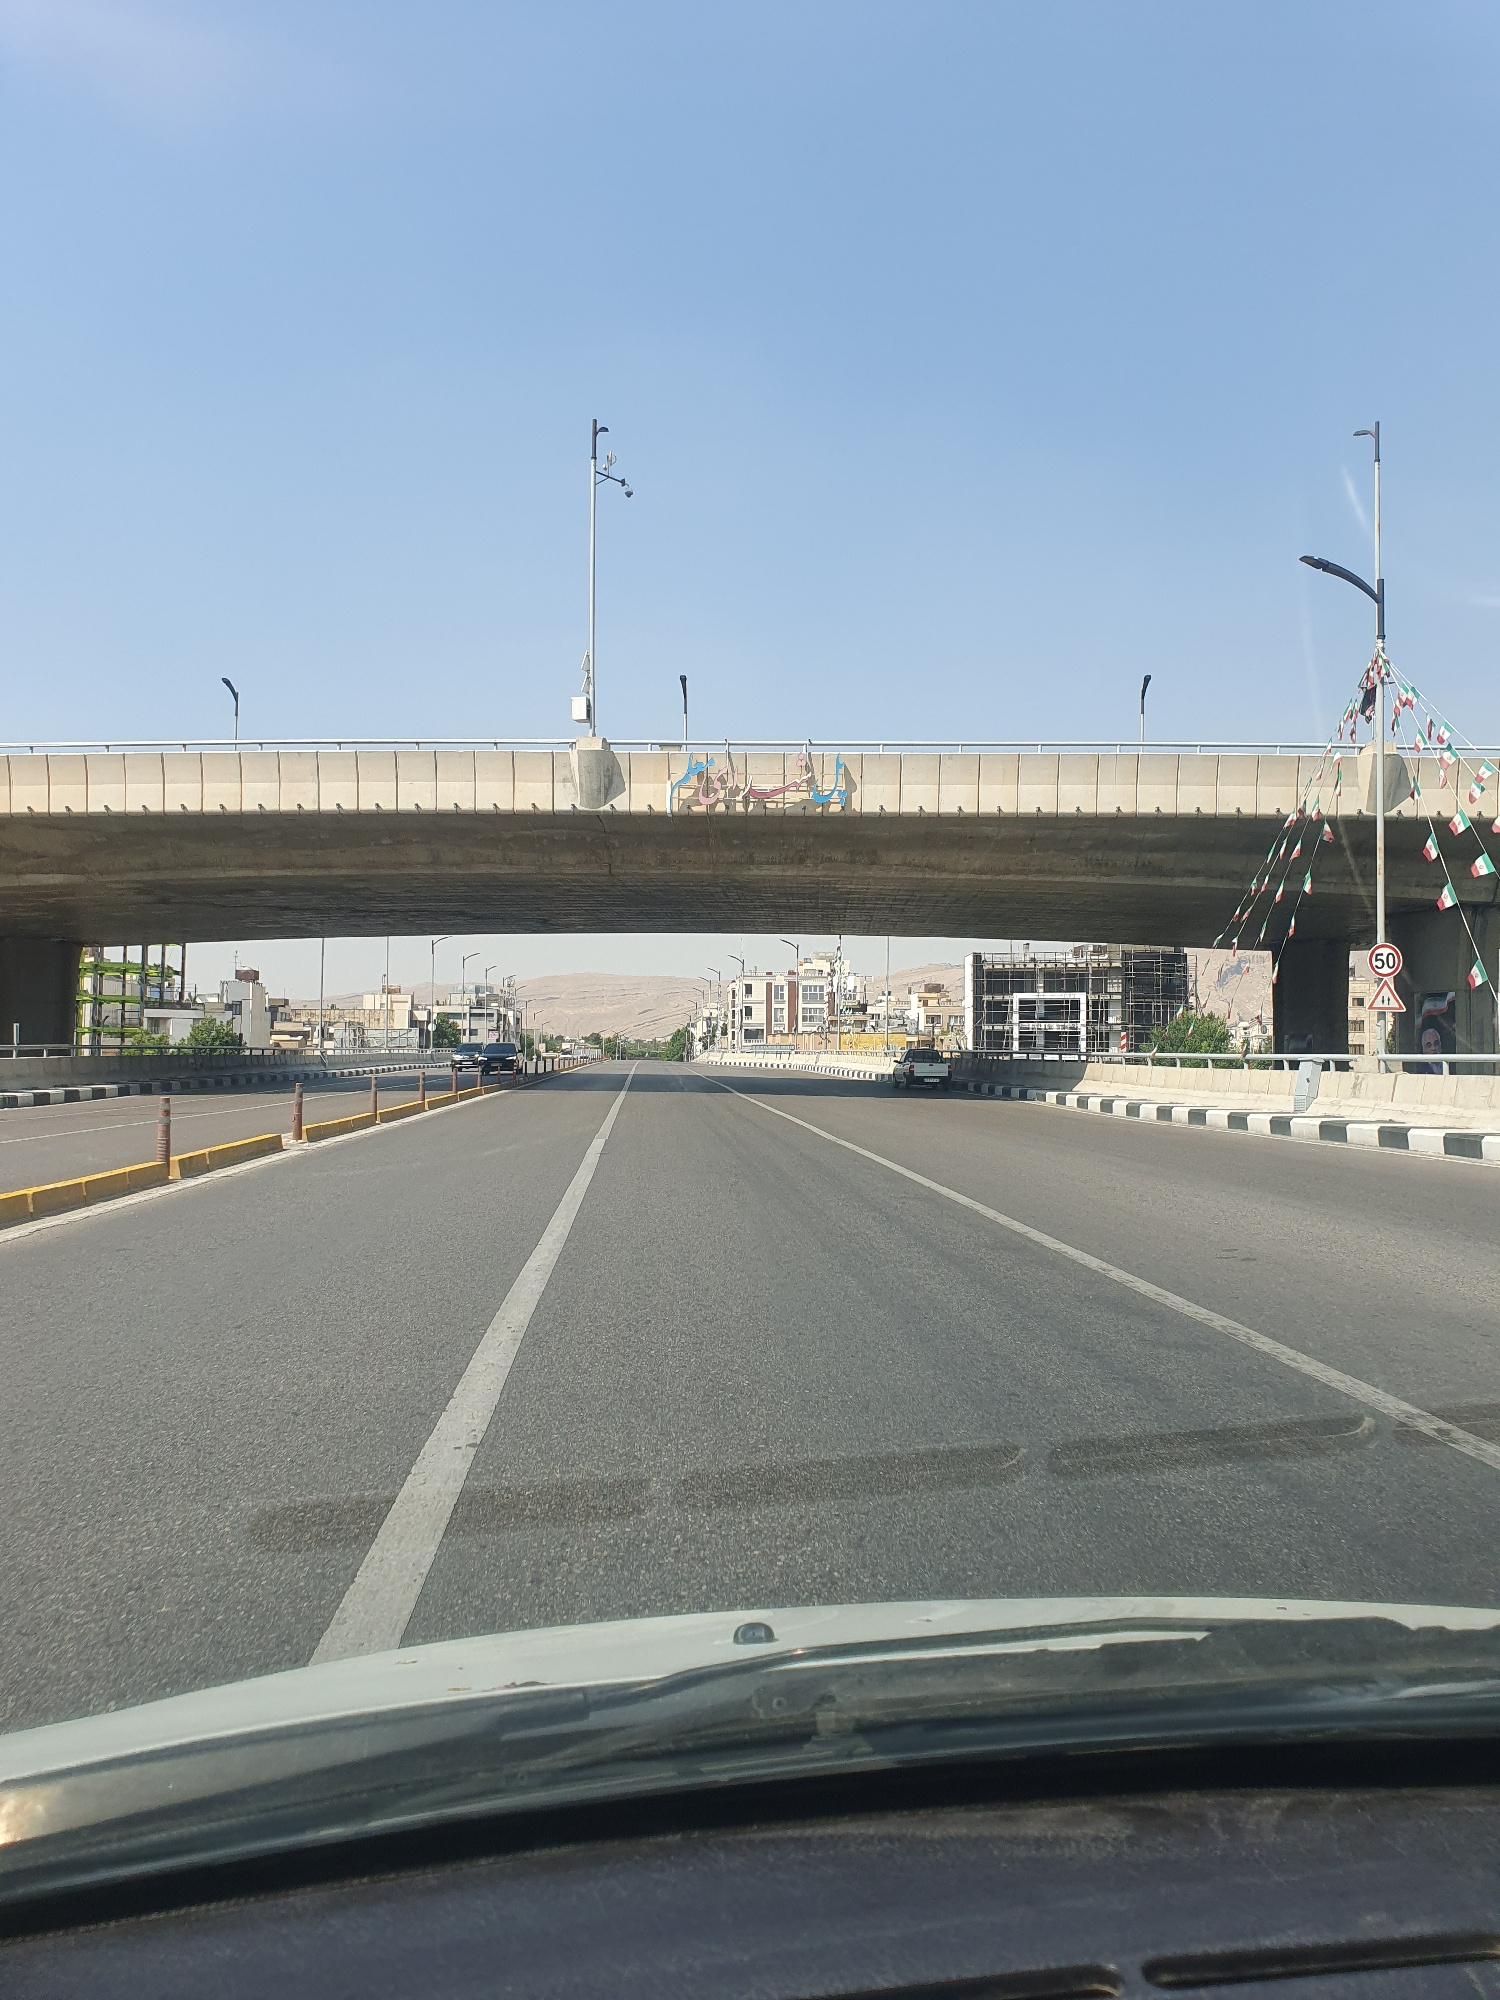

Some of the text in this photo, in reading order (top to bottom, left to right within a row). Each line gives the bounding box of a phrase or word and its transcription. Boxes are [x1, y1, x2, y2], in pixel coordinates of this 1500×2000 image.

[667, 752, 848, 816] پل شهدای معلم
[1375, 953, 1396, 969] 50
